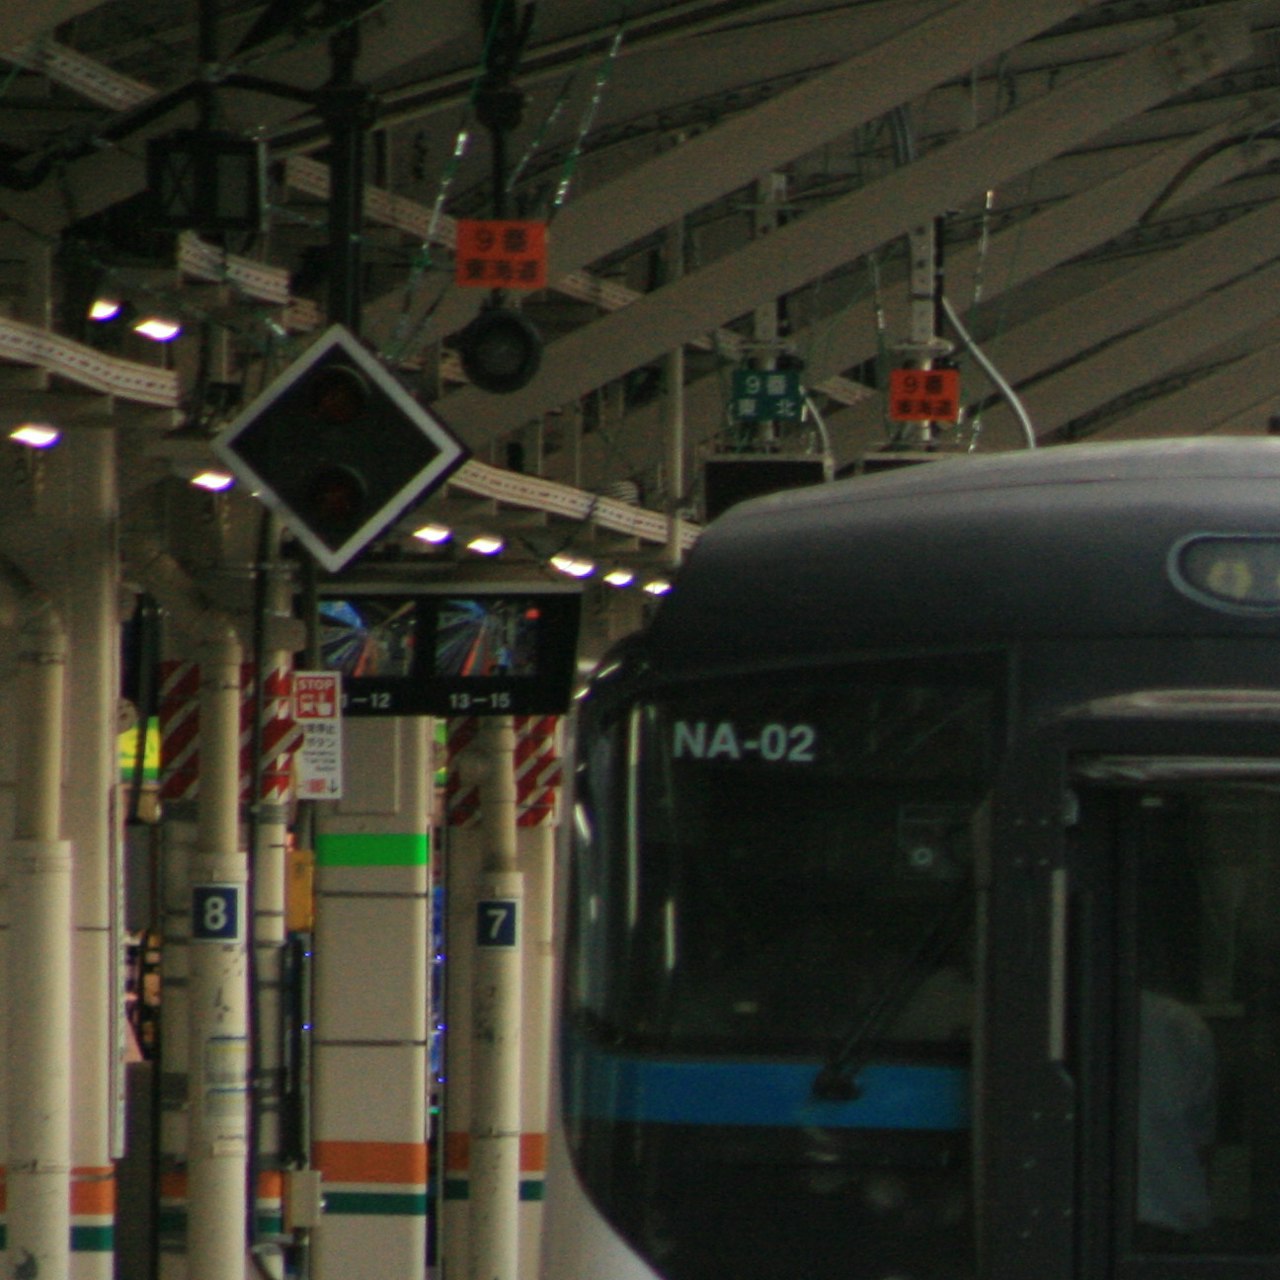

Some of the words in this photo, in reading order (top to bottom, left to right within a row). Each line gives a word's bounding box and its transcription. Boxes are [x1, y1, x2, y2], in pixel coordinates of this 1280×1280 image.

[674, 721, 815, 762] NA-02
[204, 896, 228, 932] 8
[486, 908, 508, 940] 7
